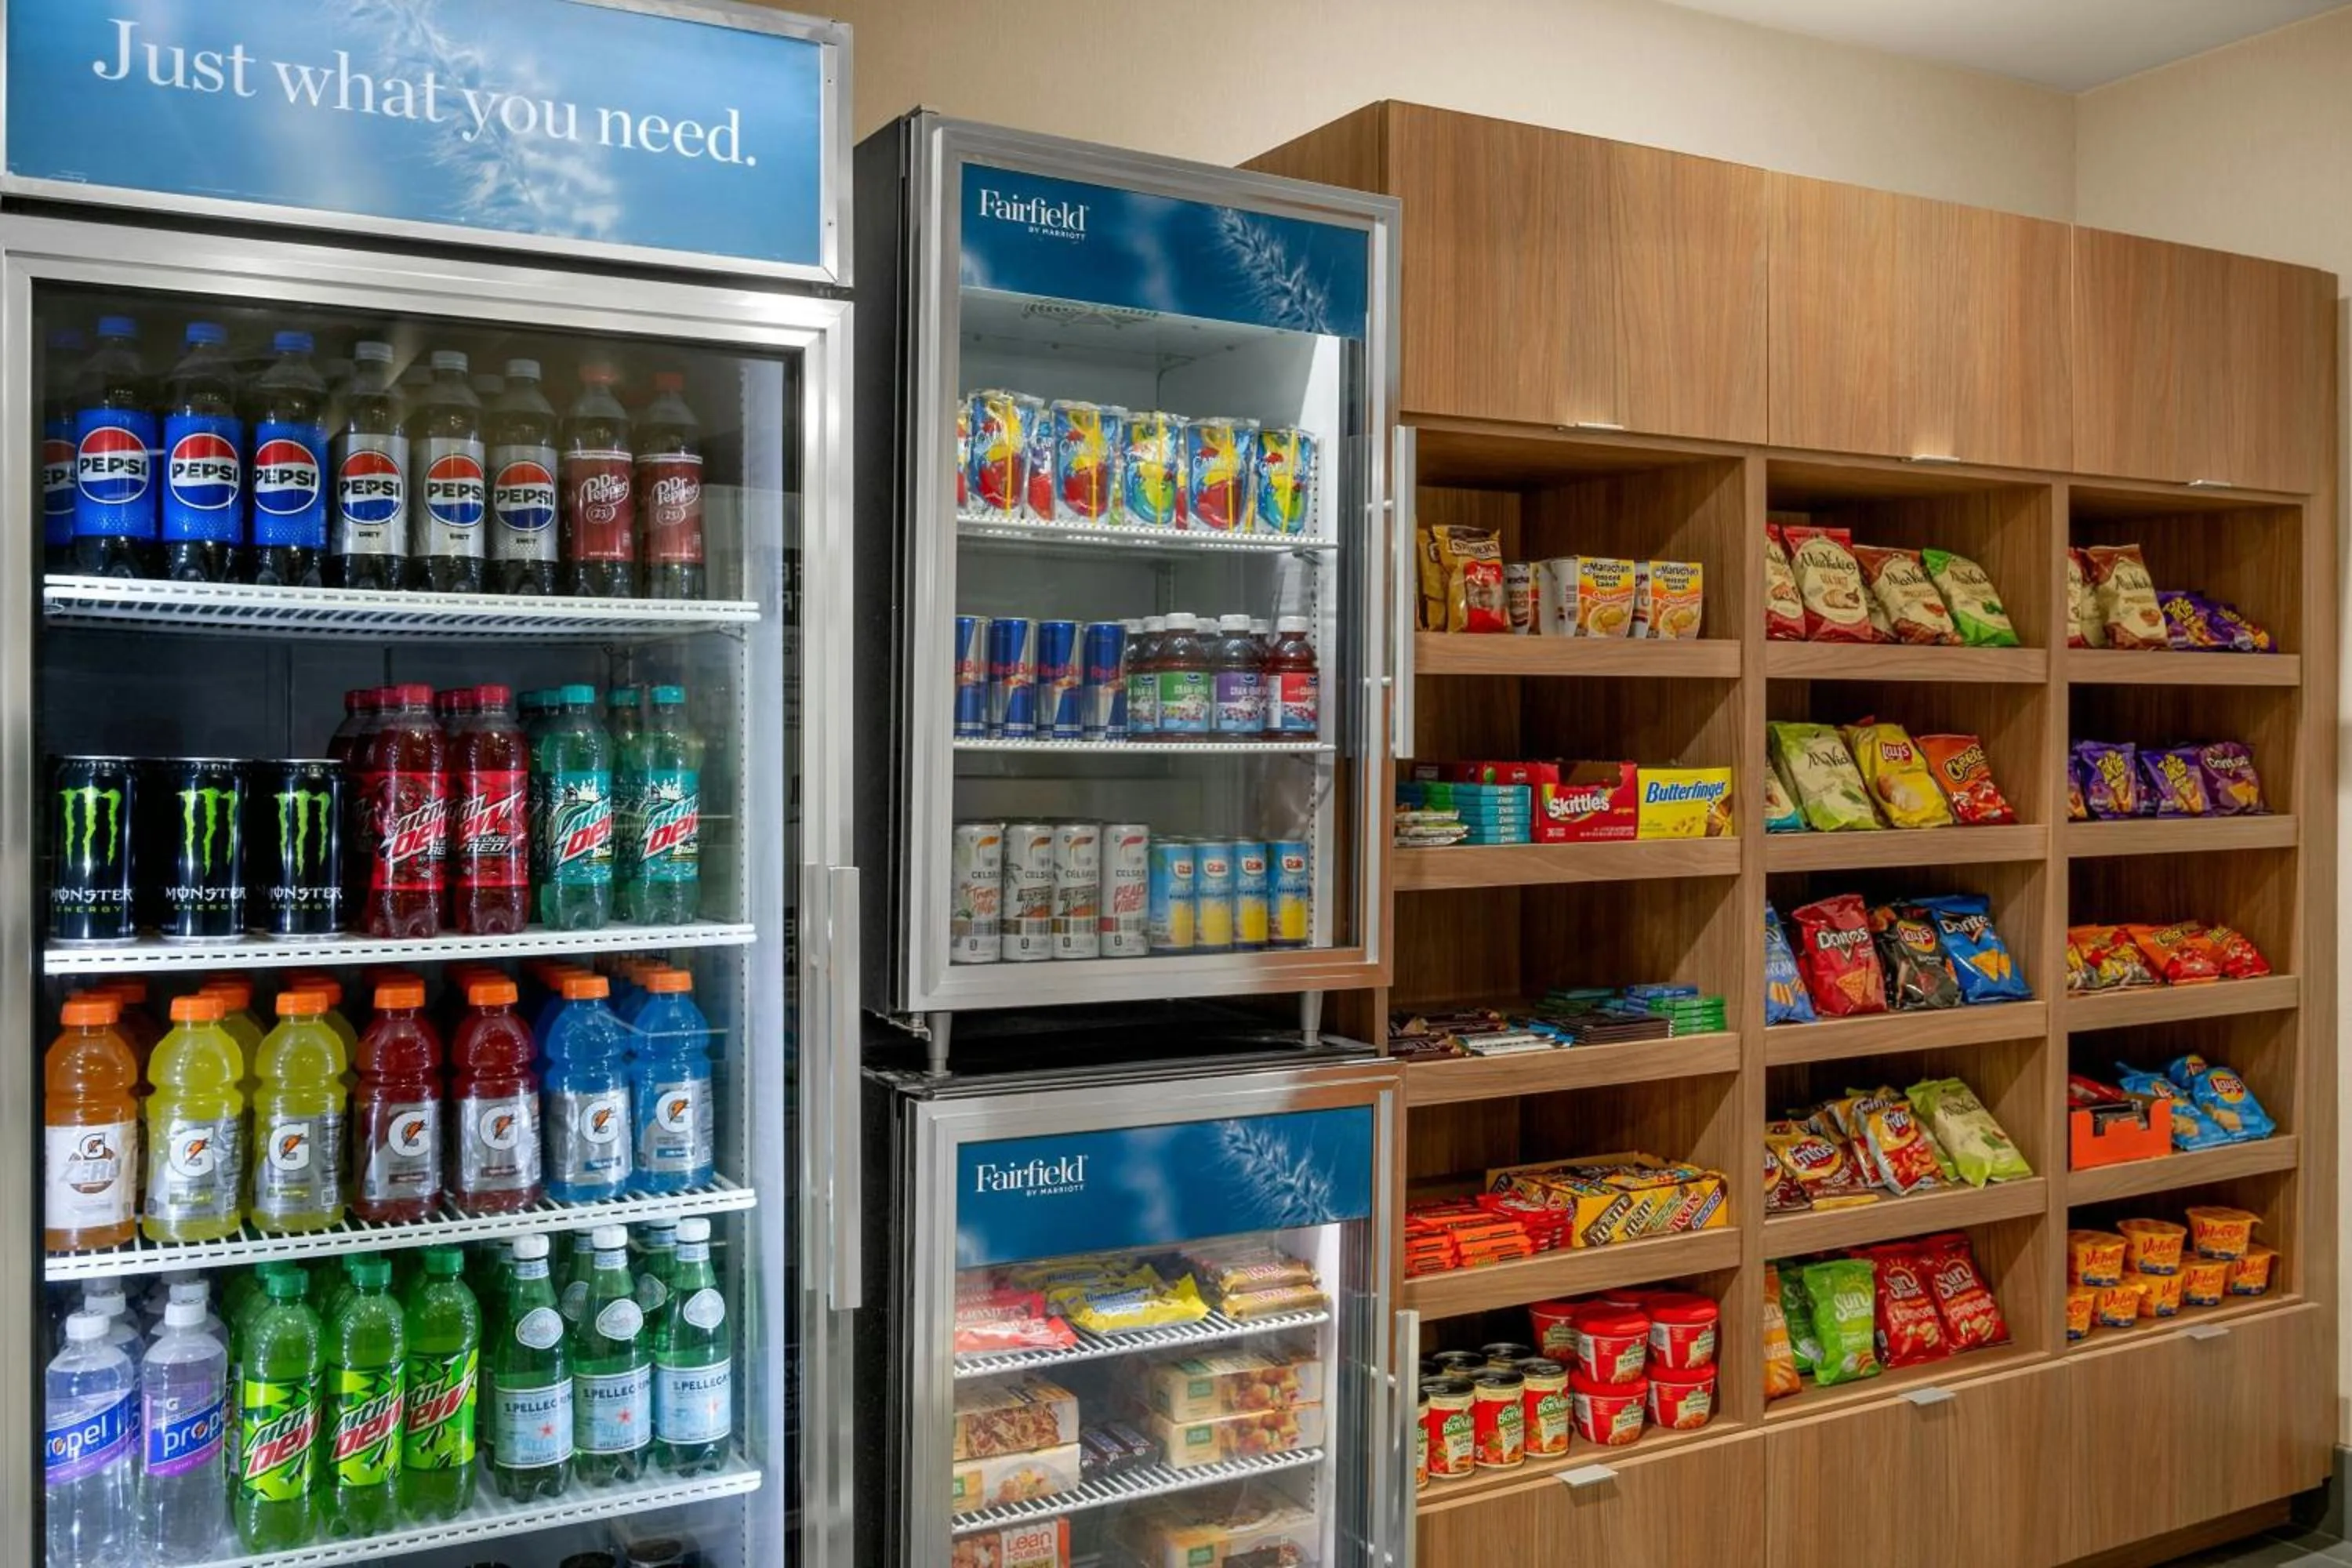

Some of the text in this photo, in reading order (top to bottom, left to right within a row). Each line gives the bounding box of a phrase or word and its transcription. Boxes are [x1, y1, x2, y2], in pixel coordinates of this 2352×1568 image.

[93, 19, 757, 167] Just what you need.
[978, 188, 1087, 232] Fairfield
[1028, 225, 1086, 240] BY MARRIOTT
[79, 457, 147, 476] PEPSI
[171, 462, 238, 481] PEPSI
[255, 468, 315, 487] PEPSI
[339, 480, 401, 497] PEPSI
[584, 477, 627, 503] Pepper
[600, 474, 619, 488] Dr
[669, 477, 688, 488] Dr
[495, 488, 554, 505] PEPSI
[1645, 779, 1726, 804] Butterfinger
[1548, 793, 1610, 818] Skittles
[466, 843, 503, 853] RED
[51, 885, 133, 904] MONSTER
[165, 884, 246, 902] MONSTER
[1817, 928, 1869, 949] Doritos
[579, 1100, 619, 1145] G
[655, 1091, 694, 1134] G
[388, 1109, 432, 1157] G
[478, 1105, 519, 1151] G
[79, 1132, 106, 1160] G
[169, 1127, 215, 1178] G
[268, 1122, 310, 1171] G
[975, 1154, 1085, 1193] Fairfield
[1026, 1185, 1085, 1198] BY MARRIOTT
[1670, 1192, 1700, 1232] TWIX
[45, 1415, 107, 1459] ropel
[1007, 1530, 1052, 1552] Lean
